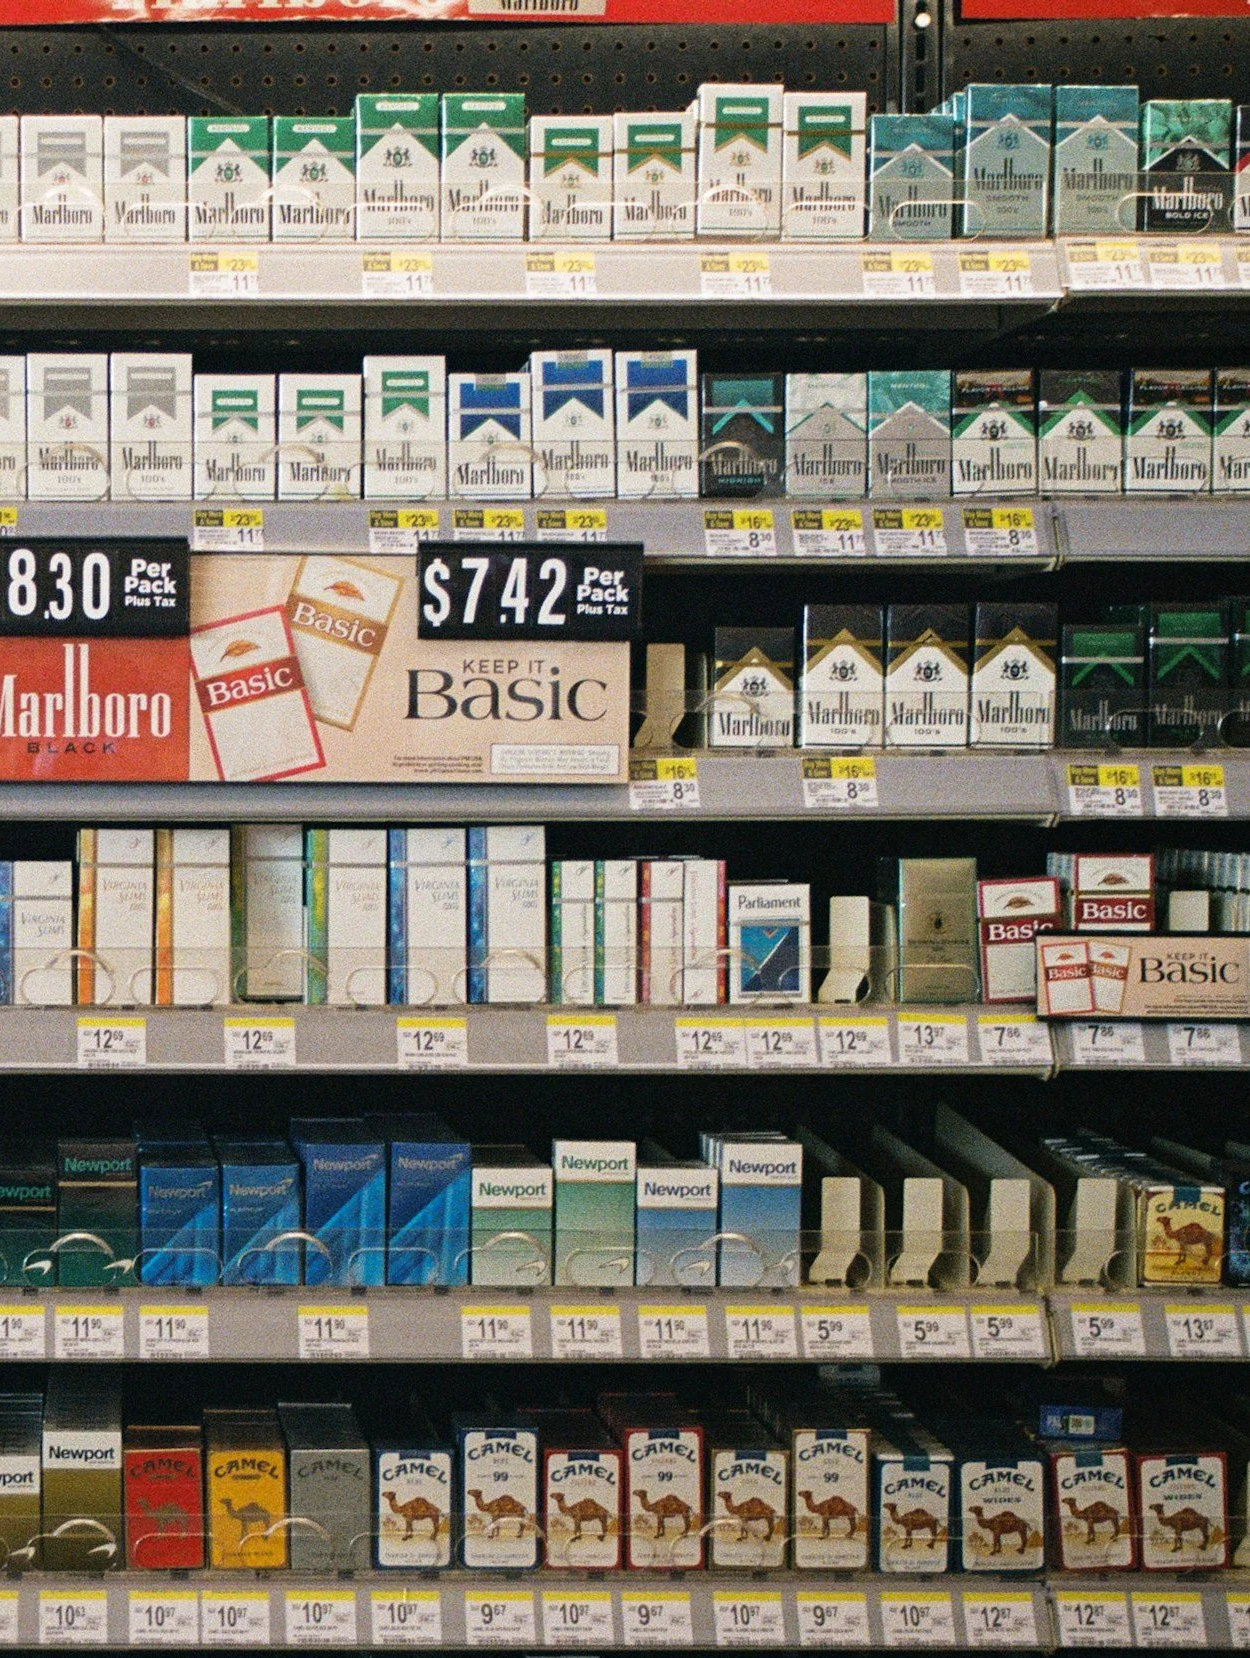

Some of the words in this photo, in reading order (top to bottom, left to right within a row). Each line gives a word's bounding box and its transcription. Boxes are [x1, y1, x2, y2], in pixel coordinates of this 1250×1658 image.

[973, 160, 1045, 193] Marlboro
[1062, 159, 1133, 191] Marlboro
[363, 181, 434, 214] Marlboro
[449, 181, 519, 214] Marlboro
[794, 181, 856, 213] Marlboro
[1153, 176, 1223, 212] Marlboro
[194, 193, 265, 226] Marlboro
[278, 193, 351, 226] Marlboro
[122, 441, 183, 470] Marlboro
[542, 440, 610, 470] Marlboro
[626, 442, 693, 473] Marlboro
[794, 443, 863, 476] Marlboro
[877, 443, 946, 476] Marlboro
[959, 447, 1032, 481] Marlboro
[1043, 446, 1118, 481] Marlboro
[1133, 446, 1207, 480] Marlboro
[206, 454, 266, 482] Marlboro
[458, 455, 525, 485] Marlboro
[130, 559, 172, 578] Per
[582, 566, 623, 586] Per
[124, 576, 177, 595] Pack
[576, 584, 630, 604] Pack
[124, 595, 151, 607] Plus
[152, 595, 177, 607] Tax
[576, 603, 603, 616] Plus
[604, 603, 629, 616] Tax
[291, 601, 378, 648] Basic
[462, 658, 519, 674] KEEP
[528, 659, 545, 674] IT
[206, 665, 295, 706] Basic
[403, 665, 608, 722] Basic
[808, 692, 879, 726] Marlboro
[978, 690, 1051, 724] Marlboro
[26, 741, 117, 755] BLACK
[737, 893, 801, 913] Parliament
[1082, 902, 1148, 920] Basic
[1049, 966, 1088, 980] Basic
[1139, 956, 1240, 984] Basic
[64, 1157, 131, 1175] Newport
[313, 1156, 378, 1174] Newport
[398, 1154, 462, 1172] Newport
[562, 1154, 628, 1173] Newport
[729, 1158, 796, 1177] Newport
[229, 1182, 292, 1199] Newport
[478, 1181, 546, 1200] Newport
[644, 1182, 711, 1200] Newport
[1155, 1201, 1221, 1216] CAMEL
[49, 1444, 115, 1464] Newport
[468, 1441, 534, 1463] CAMEL
[631, 1441, 696, 1463] CAMEL
[798, 1441, 864, 1463] CAMEL
[129, 1457, 197, 1480] CAMEL
[214, 1458, 280, 1480] CAMEL
[296, 1458, 363, 1480] CAMEL
[381, 1462, 448, 1484] CAMEL
[492, 1470, 509, 1483] 99
[550, 1464, 616, 1486] CAMEL
[657, 1471, 673, 1482] 99
[717, 1462, 783, 1485] CAMEL
[823, 1472, 839, 1483] 99
[1149, 1467, 1217, 1488] CAMEL
[884, 1477, 948, 1498] CAMEL
[967, 1474, 1034, 1494] CAMEL
[1060, 1469, 1127, 1491] CAMEL
